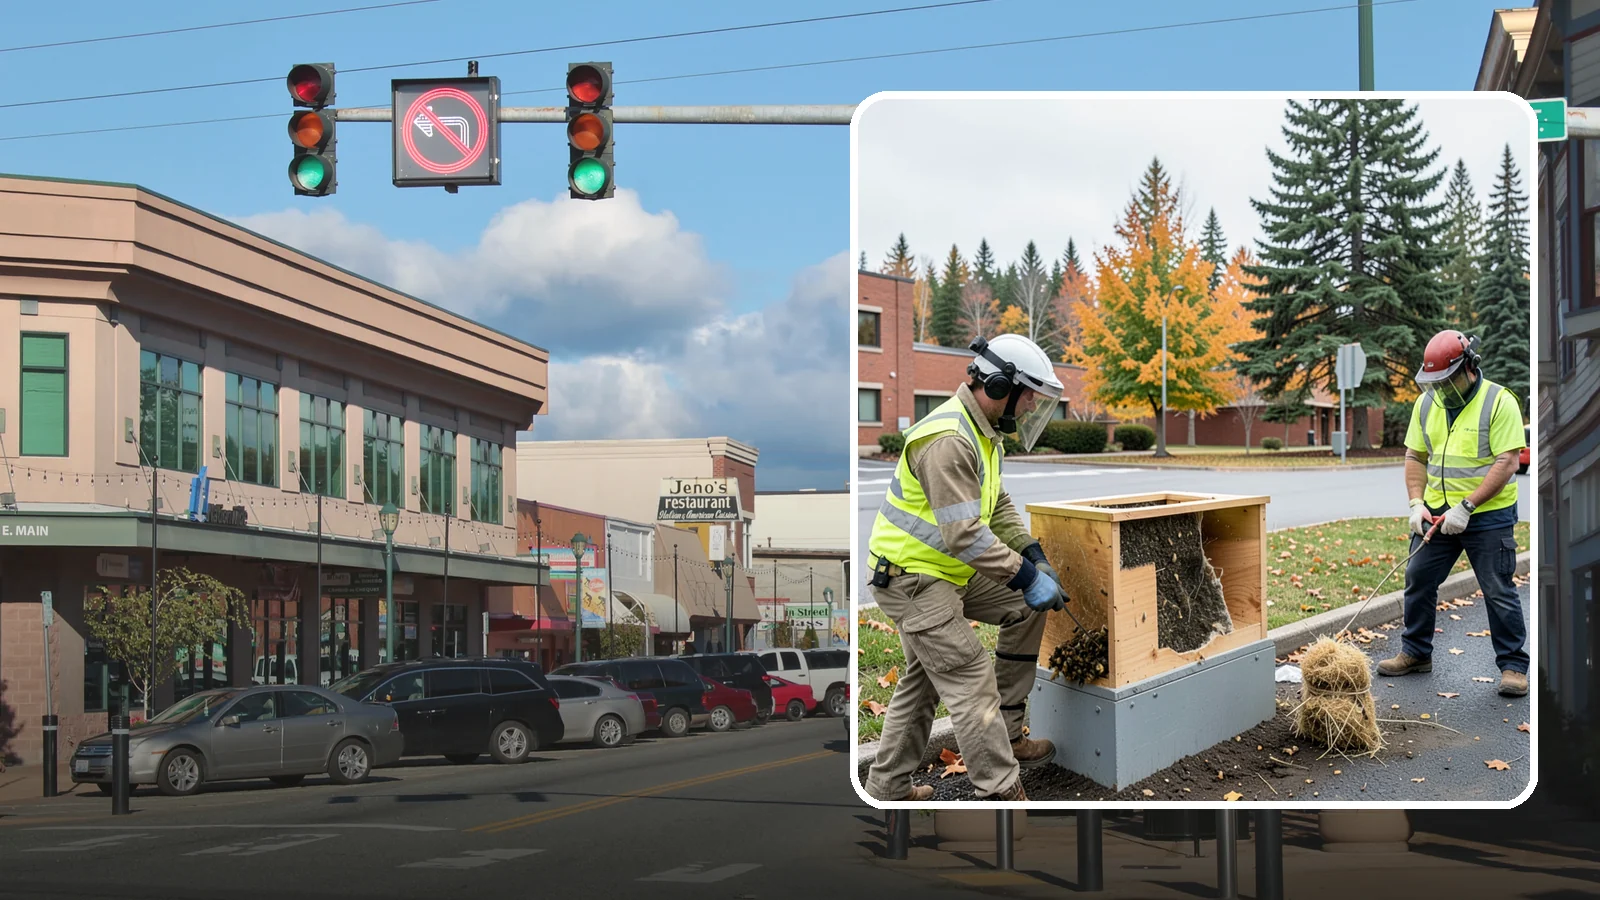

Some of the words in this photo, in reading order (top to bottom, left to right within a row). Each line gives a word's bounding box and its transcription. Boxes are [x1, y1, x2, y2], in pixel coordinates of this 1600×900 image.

[669, 480, 727, 494] Jeno's
[665, 497, 730, 509] restaurant
[659, 510, 681, 519] Italian
[686, 510, 714, 519] American
[715, 509, 737, 519] Cuisine
[2, 525, 13, 536] E.
[15, 525, 49, 536] MAIN
[797, 607, 828, 617] Street
